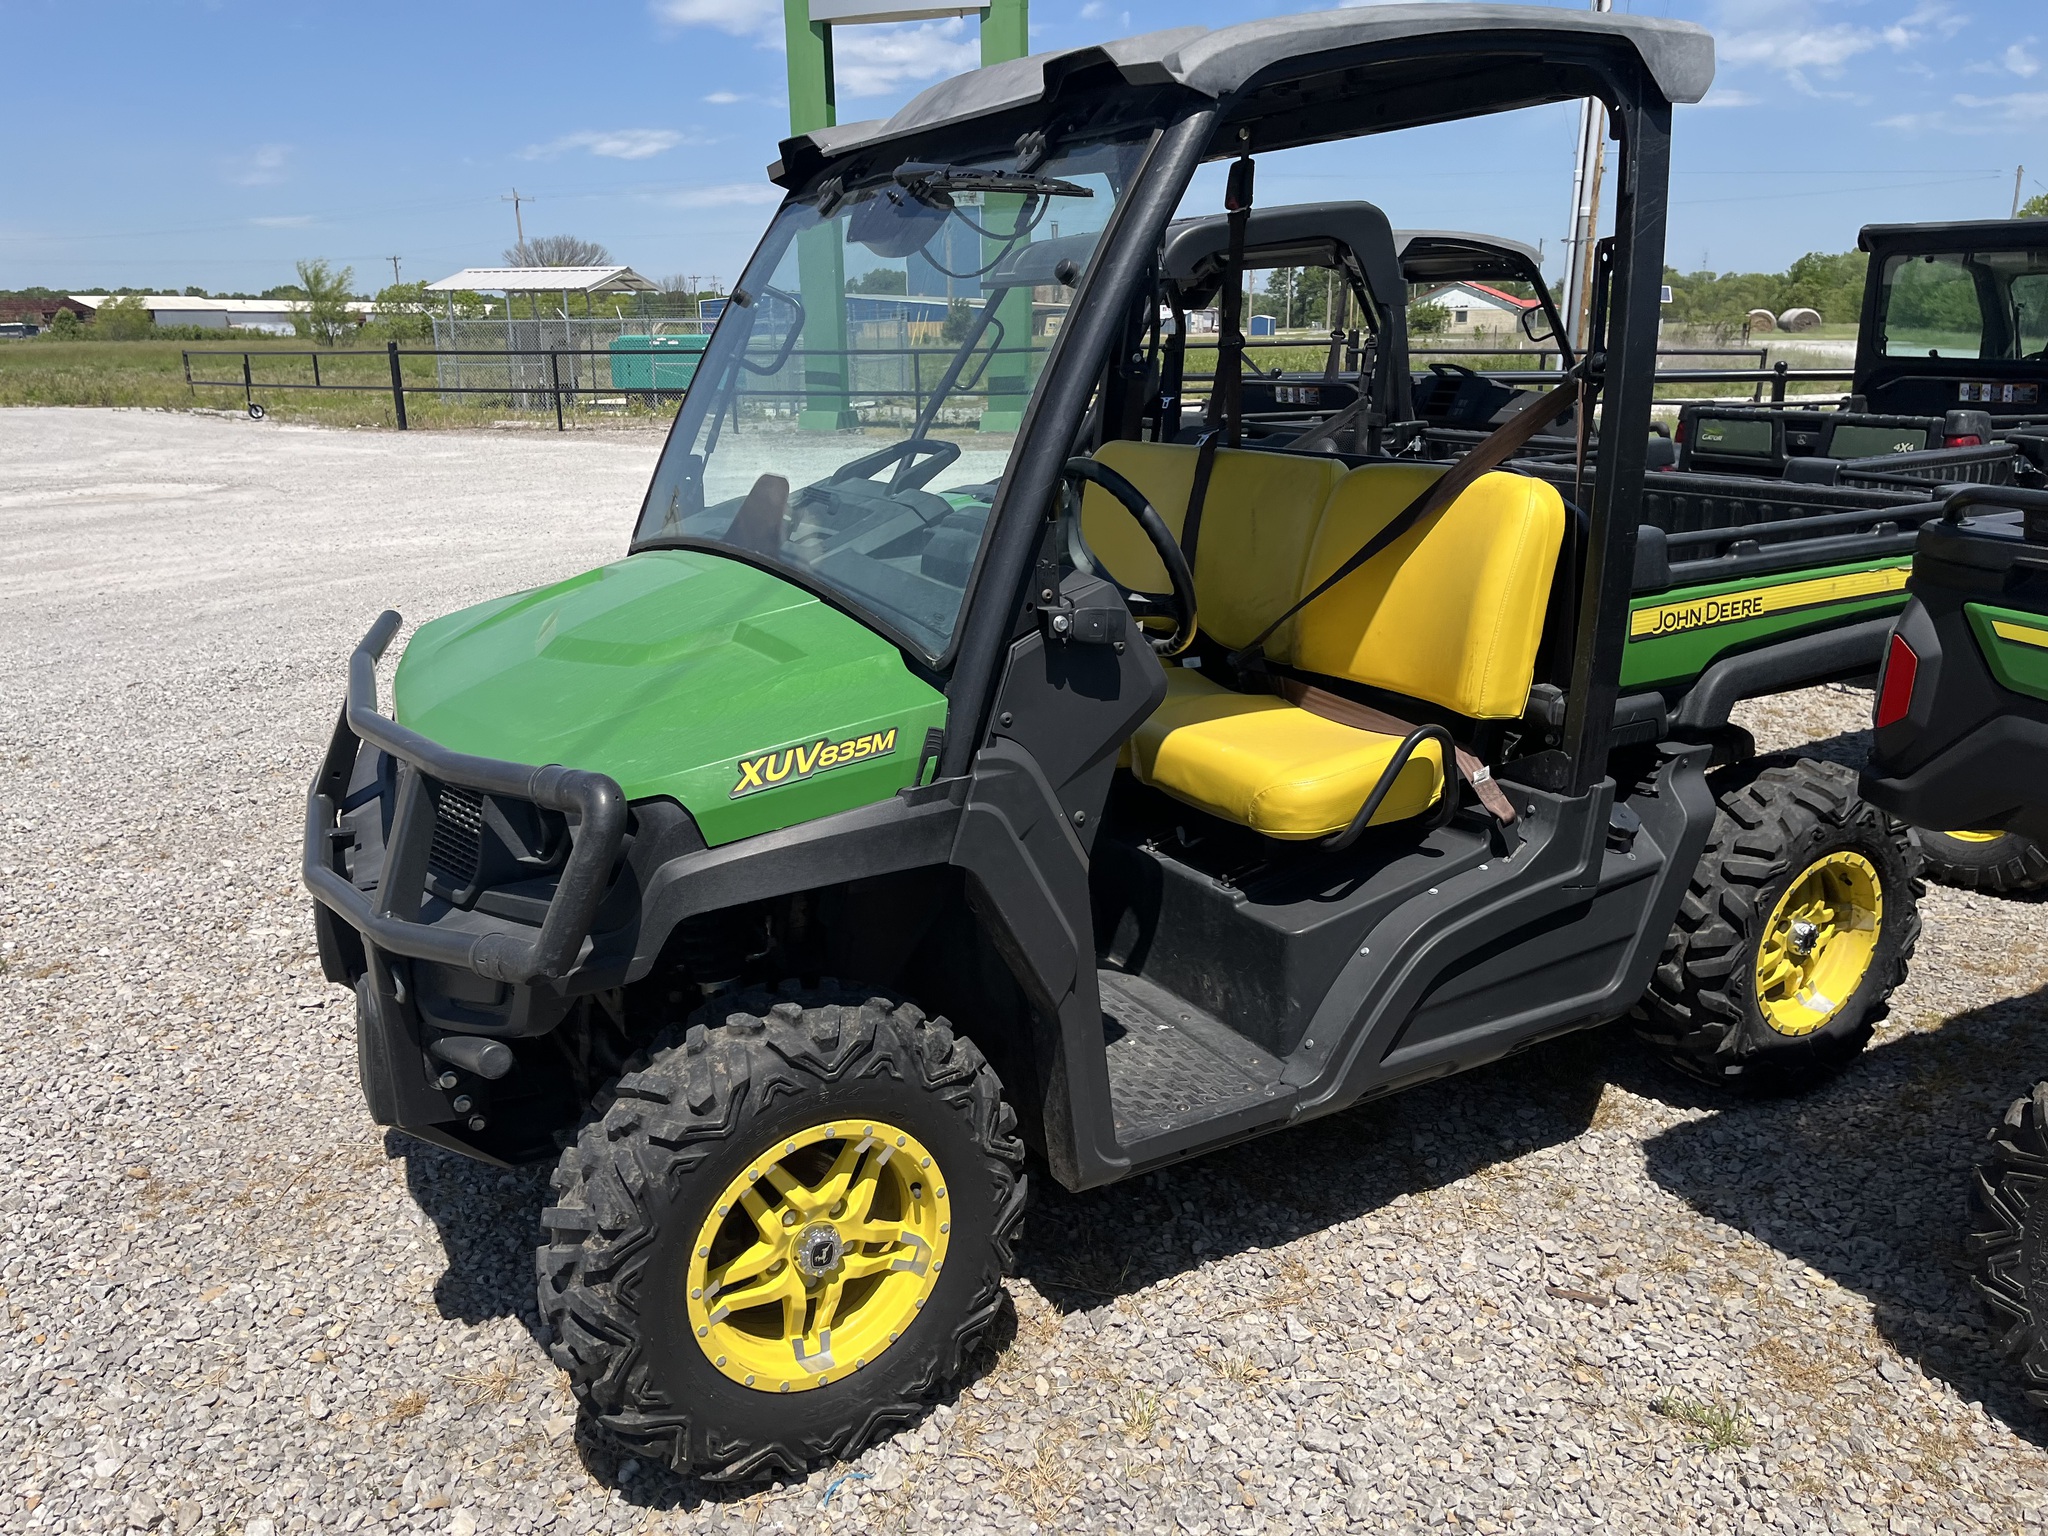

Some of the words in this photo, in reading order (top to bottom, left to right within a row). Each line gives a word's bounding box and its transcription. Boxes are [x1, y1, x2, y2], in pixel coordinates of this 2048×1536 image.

[1652, 608, 1702, 632] JOHN
[1706, 596, 1763, 622] DEERE
[732, 728, 898, 793] XUV835M
